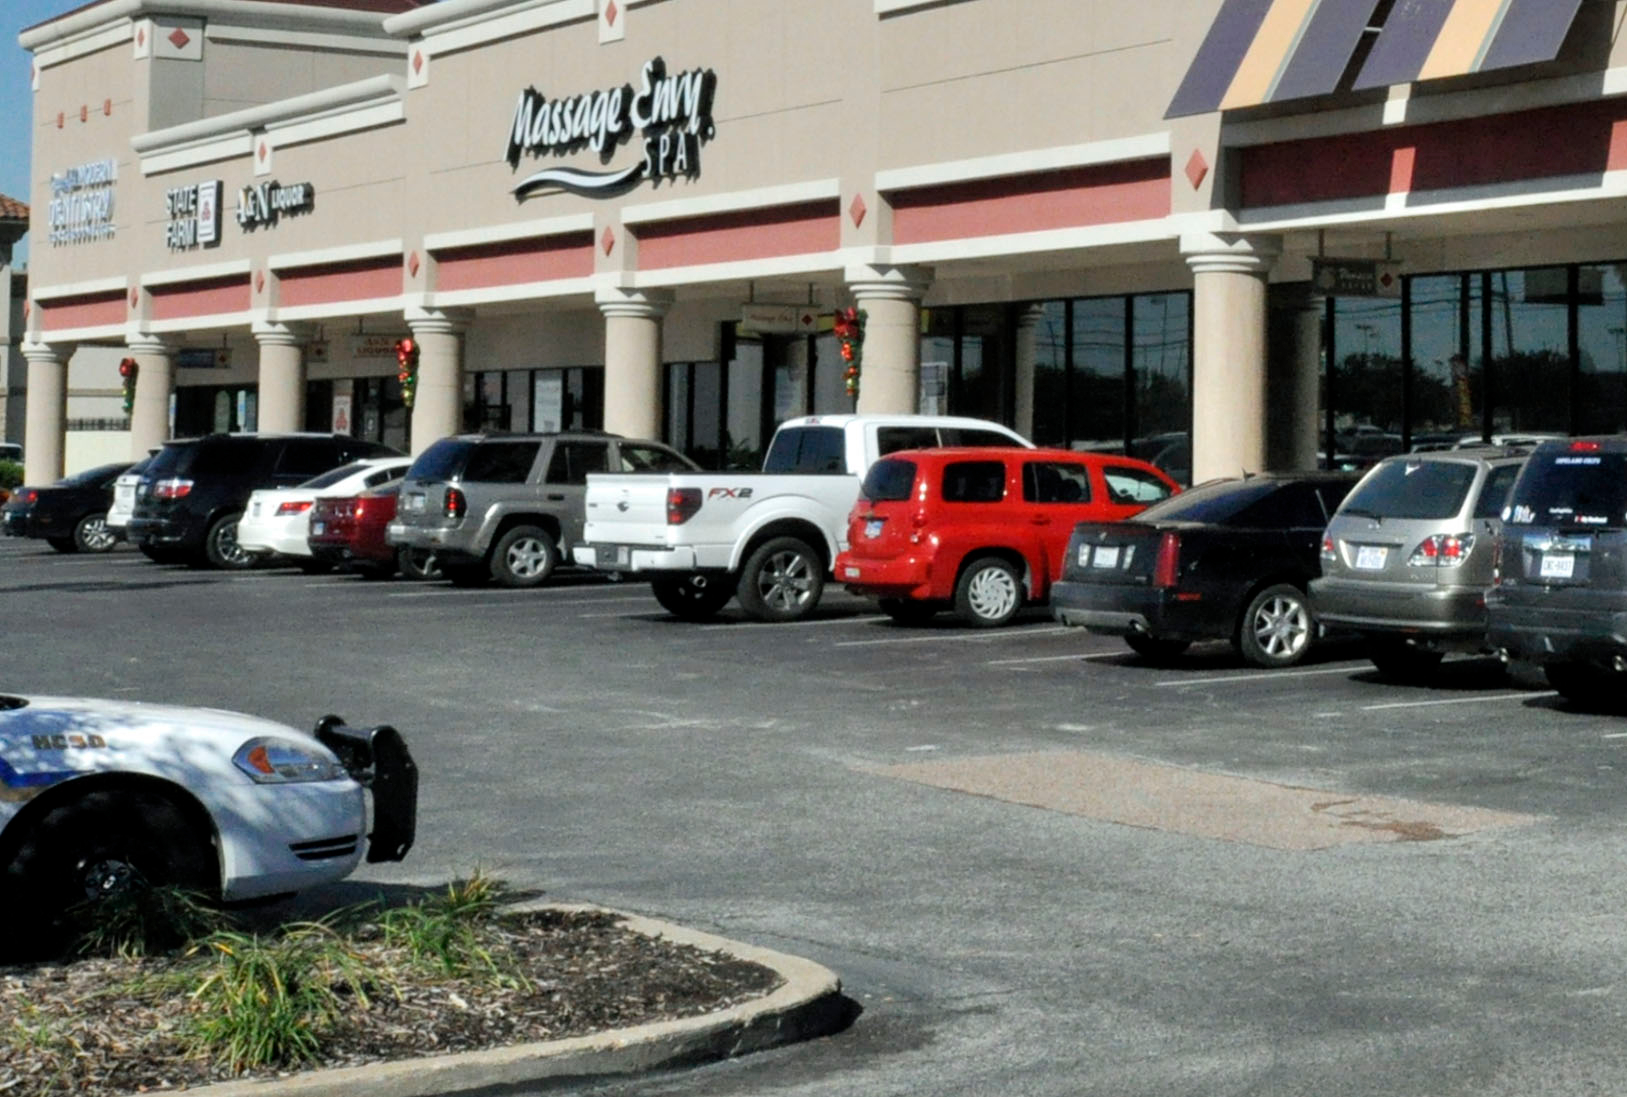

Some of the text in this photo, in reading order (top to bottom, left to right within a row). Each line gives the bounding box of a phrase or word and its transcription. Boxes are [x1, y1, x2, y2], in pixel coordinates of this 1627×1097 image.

[504, 59, 703, 162] Massage Envy
[641, 132, 688, 178] SPA
[166, 185, 198, 214] STATE
[236, 181, 305, 224] A&N LIQUOR
[166, 219, 196, 247] FARM
[707, 487, 754, 501] FX2
